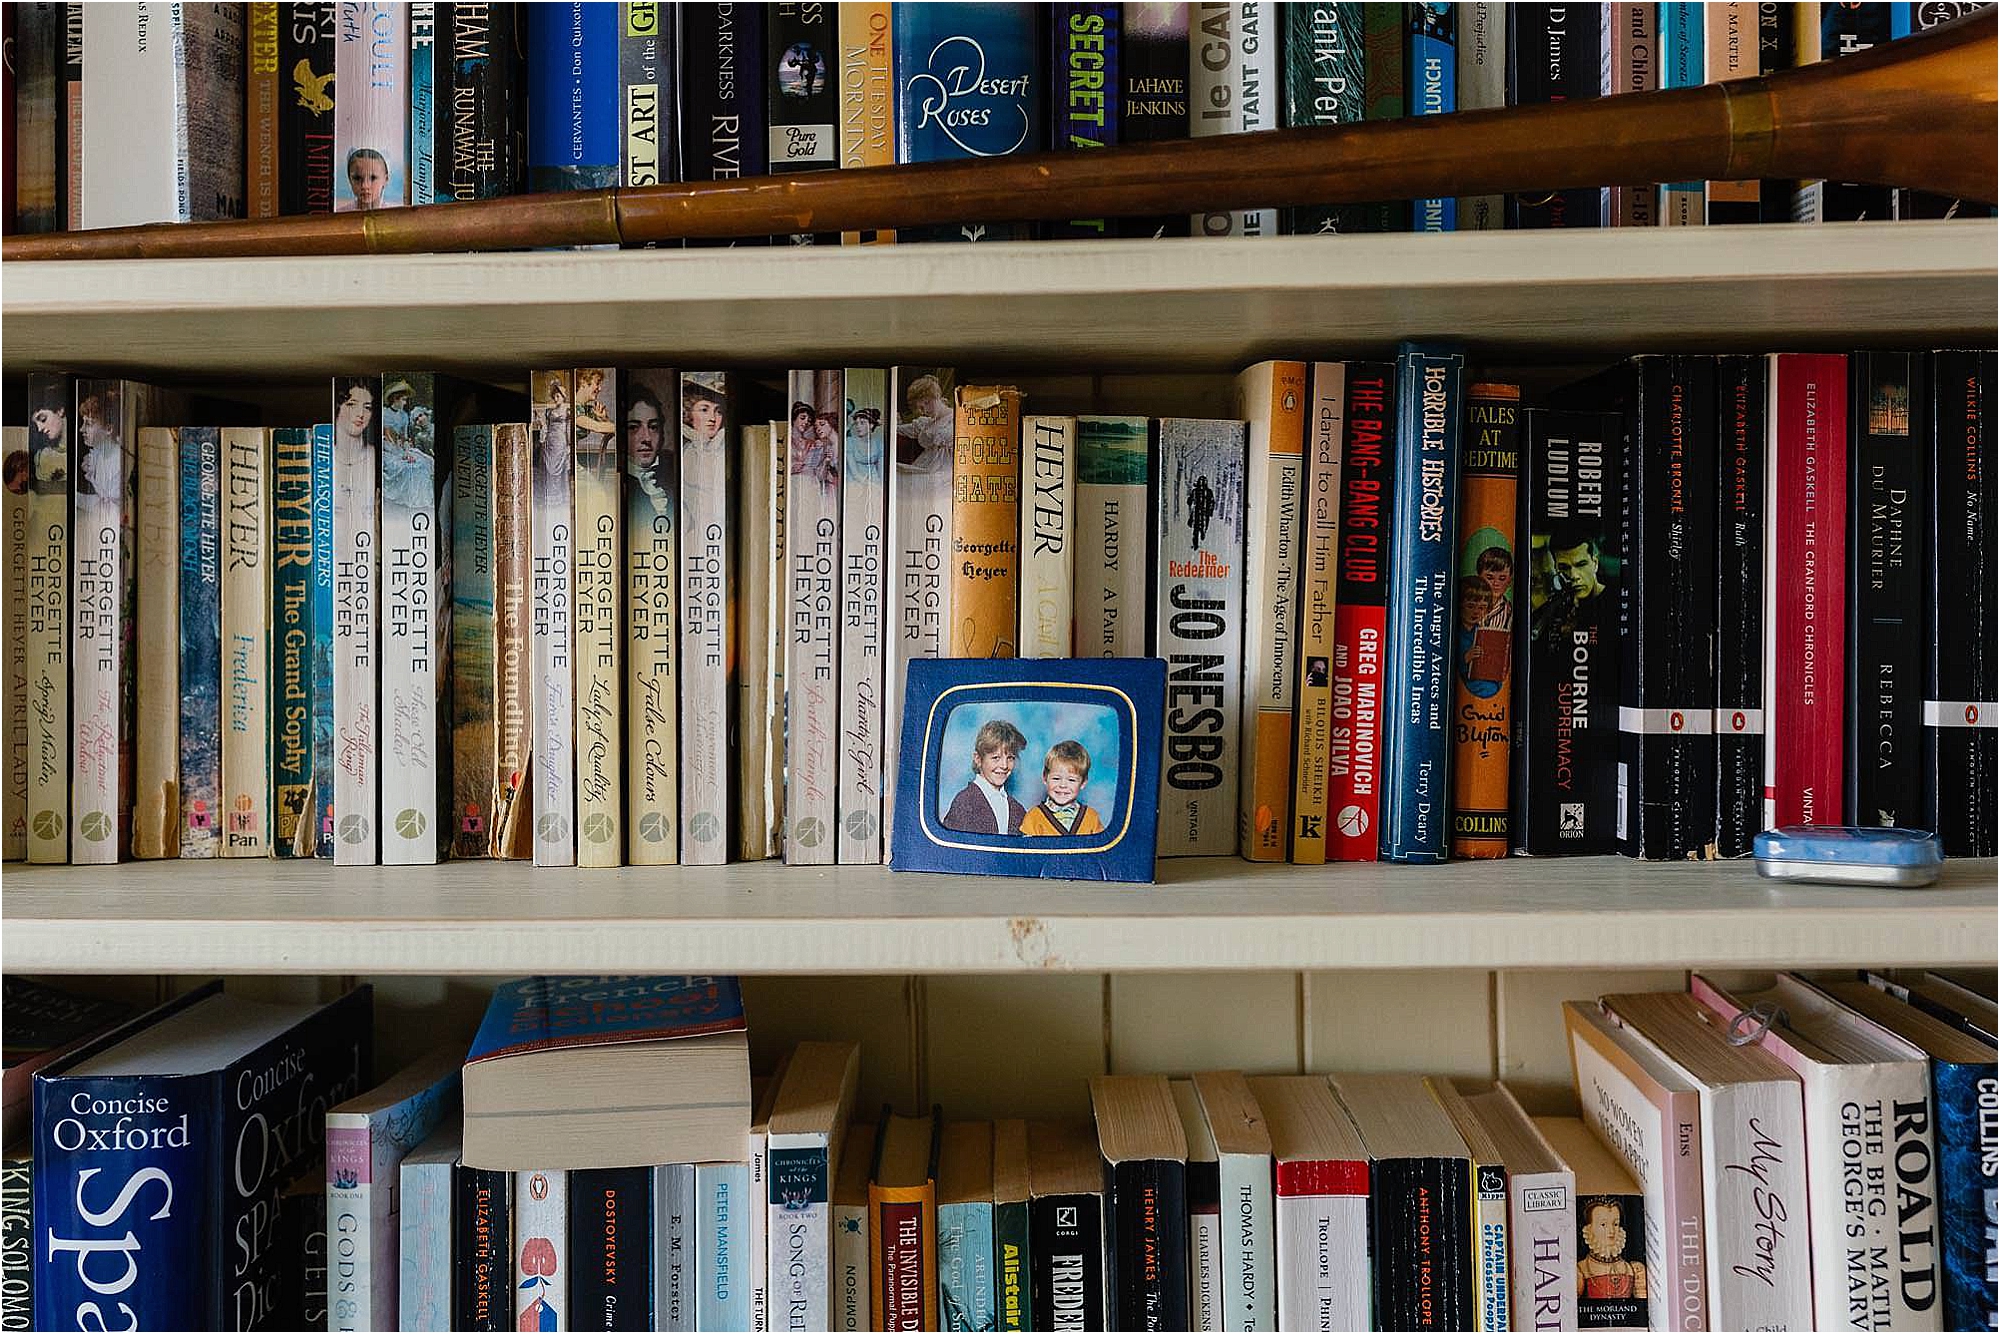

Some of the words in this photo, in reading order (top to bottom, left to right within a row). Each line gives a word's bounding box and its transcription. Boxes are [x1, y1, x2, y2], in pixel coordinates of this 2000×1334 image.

[642, 40, 655, 60] the
[718, 2, 733, 100] DARKNESS
[870, 13, 887, 57] ONE
[1474, 12, 1486, 65] Prejudice
[1729, 14, 1739, 71] MARTEL
[573, 52, 582, 75] Don
[642, 65, 655, 80] of
[928, 36, 1030, 98] Desert
[1069, 13, 1104, 127] SECRET
[1129, 79, 1183, 93] LAHAYE
[455, 87, 474, 174] RUNAWAY
[573, 88, 582, 159] CERVANTES
[631, 89, 655, 146] ART
[871, 65, 888, 151] TUESDAY
[1125, 100, 1185, 116] JENKINS
[477, 139, 494, 171] THE
[785, 128, 816, 142] Pure
[788, 142, 817, 158] Gold
[1350, 378, 1383, 411] THE
[1422, 367, 1446, 451] HORRIBLE
[1470, 406, 1514, 425] TALES
[1672, 385, 1681, 457] CHARLOTTE
[1806, 383, 1816, 451] ELIZABETH
[1967, 376, 1977, 420] WILKIE
[1319, 407, 1335, 463] dared
[1479, 429, 1503, 446] AT
[1967, 426, 1976, 481] COLLINS
[1034, 425, 1064, 559] HEYER
[1281, 466, 1296, 498] Edith
[1319, 470, 1333, 491] to
[1347, 419, 1383, 529] BANG-BANG
[1420, 458, 1446, 542] HISTORIES
[1547, 439, 1570, 517] LUDLUM
[1577, 442, 1601, 517] ROBERT
[1806, 457, 1816, 512] GASKELL
[1871, 466, 1885, 491] DU
[1966, 490, 1977, 508] No
[228, 440, 258, 580] HEYER
[277, 442, 312, 568] HEYER
[1278, 500, 1294, 559] Wharton
[1317, 496, 1334, 530] call
[1890, 488, 1907, 568] DAPHNE
[1104, 501, 1119, 571] HARDY
[1199, 550, 1217, 564] The
[1314, 535, 1331, 573] Him
[1345, 535, 1377, 582] CLUB
[1669, 523, 1683, 561] Shirley
[1805, 521, 1815, 546] THE
[1871, 504, 1888, 590] MAURIER
[30, 556, 46, 633] HEYER
[47, 524, 63, 665] GEORGETTE
[579, 549, 596, 633] HEYER
[597, 514, 614, 666] GEORGETTE
[1103, 587, 1118, 601] A
[1169, 560, 1229, 578] Redeemer
[1414, 575, 1427, 604] The
[1432, 571, 1445, 599] The
[1804, 551, 1815, 619] CRANFORD
[284, 580, 306, 621] The
[503, 578, 524, 628] The
[633, 551, 650, 641] HEYER
[652, 515, 671, 677] GEORGETTE
[1170, 584, 1226, 639] JO
[1273, 596, 1288, 621] Age
[1311, 578, 1330, 644] Father
[1103, 607, 1118, 644] PAIR
[1274, 622, 1289, 636] of
[1358, 628, 1377, 675] GREG
[1412, 608, 1427, 683] Incredible
[1428, 604, 1444, 648] Angry
[1588, 625, 1598, 644] THE
[283, 630, 305, 700] Grand
[1272, 634, 1287, 700] Innocence
[1336, 644, 1347, 667] AND
[1430, 652, 1443, 699] Aztecs
[1572, 630, 1588, 728] BOURNE
[1803, 625, 1814, 705] CHRONICLES
[36, 669, 59, 724] Sprig
[230, 633, 256, 732] Frederica
[499, 637, 524, 771] Foundling
[586, 674, 609, 721] Lady
[636, 672, 666, 736] False
[1333, 675, 1352, 719] JOAO
[1411, 688, 1424, 724] Incas
[278, 705, 305, 775] Sophy
[584, 714, 608, 737] of
[1167, 654, 1224, 789] NESBO
[1303, 708, 1312, 725] with
[1314, 698, 1327, 748] BILQUIS
[1354, 683, 1376, 795] MARINOVICH
[1429, 703, 1443, 729] and
[1457, 721, 1512, 745] Blyton
[1461, 704, 1505, 723] Enid
[1557, 683, 1572, 789] SUPREMACY
[1879, 664, 1893, 770] REBECCA
[39, 721, 58, 787] Muslin
[1303, 727, 1311, 756] Richard
[1331, 727, 1350, 776] SILVA
[585, 741, 607, 803] Quality
[644, 739, 666, 803] Colours
[1301, 758, 1311, 794] Schneider
[1312, 751, 1324, 806] SHEIKH
[1416, 760, 1431, 797] Terry
[228, 833, 258, 848] Pan
[1415, 800, 1430, 843] Deary
[1457, 817, 1507, 832] COLLINS
[71, 1093, 169, 1115] Concise
[1865, 1100, 1882, 1154] THE
[54, 1114, 190, 1151] Oxford
[1680, 1123, 1693, 1157] Enss
[1726, 1119, 1783, 1186] My
[754, 1153, 762, 1182] James
[1841, 1102, 1864, 1237] GEORGE'S
[1867, 1166, 1885, 1217] BFG
[479, 1190, 487, 1257] ELIZABETH
[671, 1215, 681, 1229] E.
[718, 1183, 727, 1221] PETER
[1144, 1189, 1154, 1231] HENRY
[1241, 1185, 1252, 1246] THOMAS
[1420, 1188, 1430, 1254] ANTHONY
[1893, 1096, 1935, 1311] ROALD
[338, 1214, 357, 1292] GODS
[605, 1190, 615, 1284] DOSTOYEVSKY
[671, 1237, 681, 1256] M.
[790, 1224, 806, 1277] SONG
[888, 1245, 896, 1261] The
[900, 1217, 916, 1245] THE
[1199, 1226, 1209, 1279] CHARLES
[1319, 1216, 1330, 1278] TROLLOPE
[1495, 1224, 1504, 1274] CAPTAIN
[1682, 1216, 1699, 1265] THE
[1733, 1188, 1787, 1286] Story
[717, 1226, 727, 1300] MANSFIELD
[900, 1250, 918, 1315] INVISIBLE
[1004, 1244, 1019, 1326] Alistair
[1145, 1237, 1155, 1280] JAMES
[1243, 1251, 1254, 1299] HARDY
[479, 1264, 487, 1320] GASKELL
[671, 1264, 681, 1321] Forster
[794, 1282, 801, 1296] OF
[888, 1263, 897, 1310] Paranormal
[1201, 1282, 1210, 1331] DICKENS
[1422, 1260, 1431, 1325] TROLLOPE
